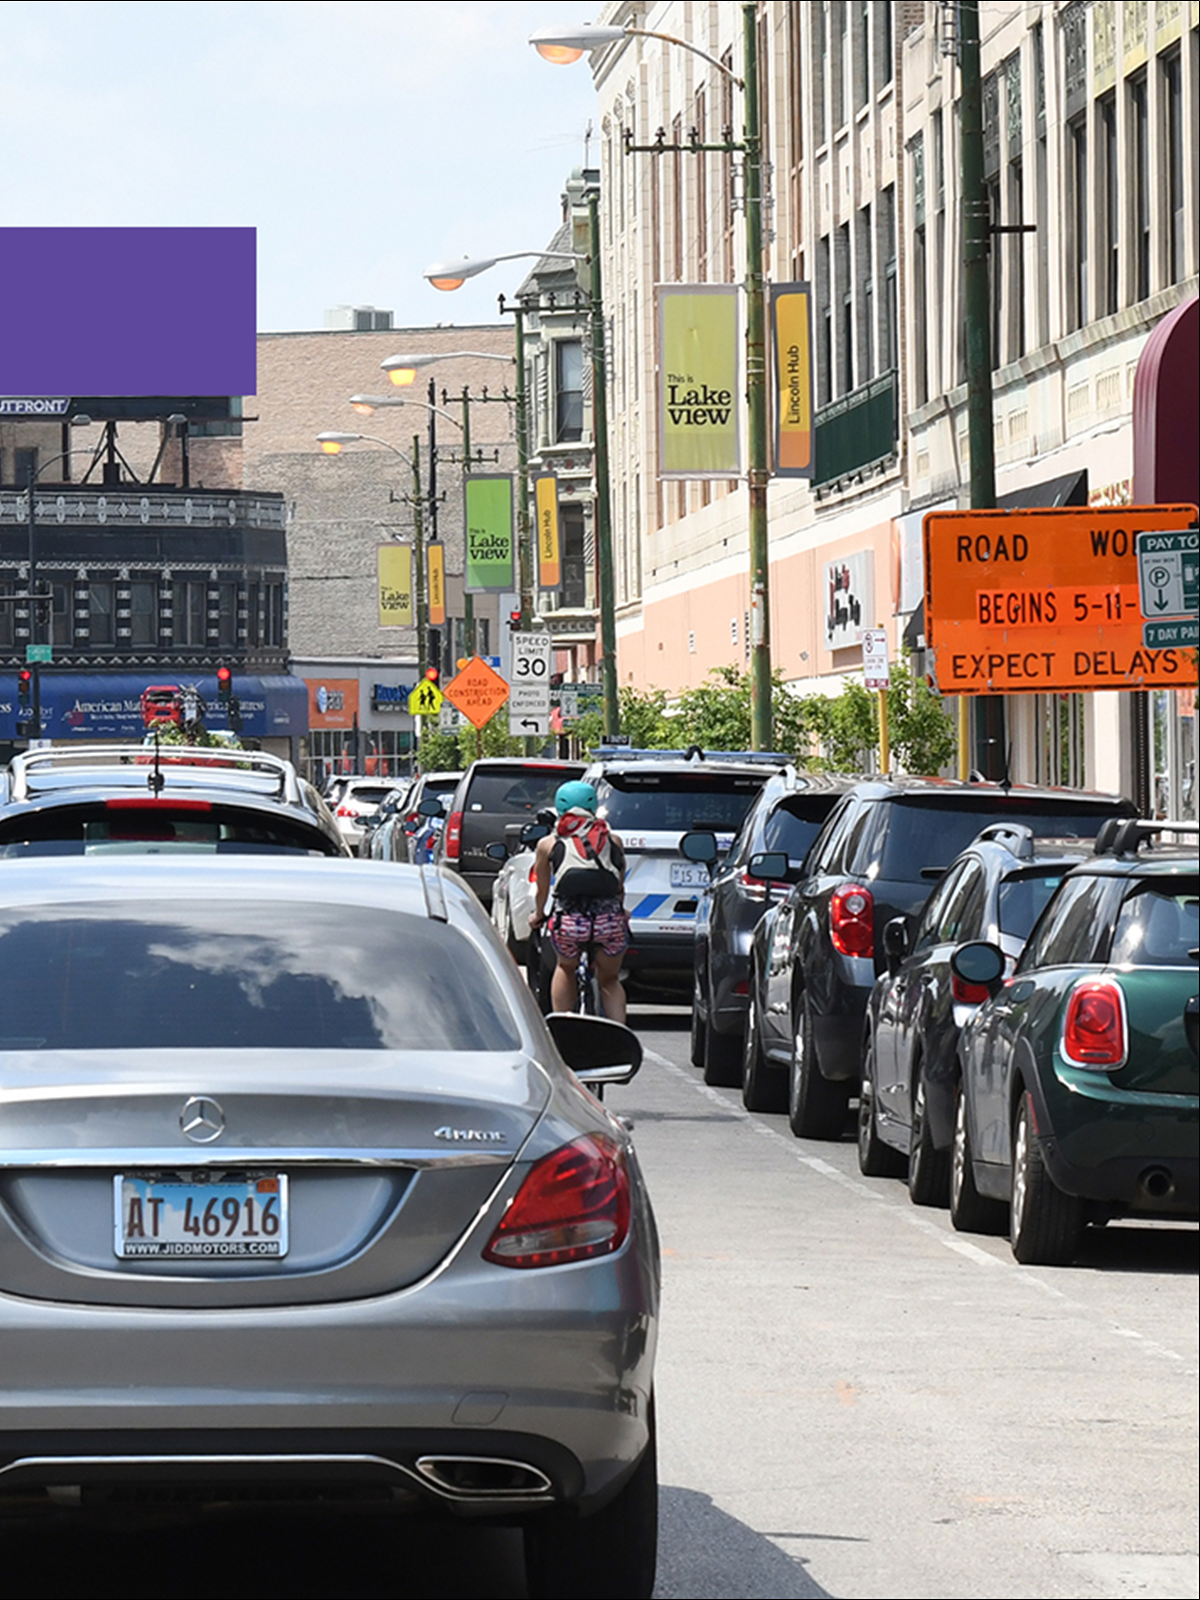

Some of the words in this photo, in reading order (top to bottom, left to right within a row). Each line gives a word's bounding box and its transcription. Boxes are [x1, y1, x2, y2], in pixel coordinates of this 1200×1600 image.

[787, 345, 799, 374] Hub
[667, 374, 685, 383] This
[687, 374, 694, 383] is
[668, 385, 731, 406] Lake
[788, 376, 800, 424] Lincoln
[668, 408, 731, 425] view
[542, 509, 551, 531] Hub
[470, 534, 509, 548] Lake
[543, 532, 552, 559] Lincoln
[957, 534, 1029, 562] ROAD
[1090, 529, 1138, 557] WO
[1147, 537, 1174, 551] PAY
[1178, 535, 1199, 549] TO
[470, 549, 509, 560] view
[380, 591, 409, 601] Lake
[380, 601, 409, 610] view
[979, 592, 1057, 625] BEGINS
[1074, 593, 1137, 621] 5-11-
[516, 636, 549, 646] SPEED
[1148, 629, 1155, 642] 7
[1158, 627, 1178, 641] DAY
[1181, 626, 1199, 639] PAI
[519, 647, 544, 655] LIMIT
[517, 658, 546, 677] 30
[953, 652, 1056, 679] EXPECT
[1074, 649, 1178, 676] DELAYS
[467, 678, 489, 687] ROAD
[449, 687, 507, 698] CONSTRUCTION
[73, 699, 123, 711] American
[466, 698, 492, 706] AHEAD
[512, 700, 547, 708] ENFORCED
[127, 1197, 164, 1237] AT
[183, 1196, 279, 1237] 46916
[125, 1242, 278, 1254] WWW.JIDDMOTORS.COM
